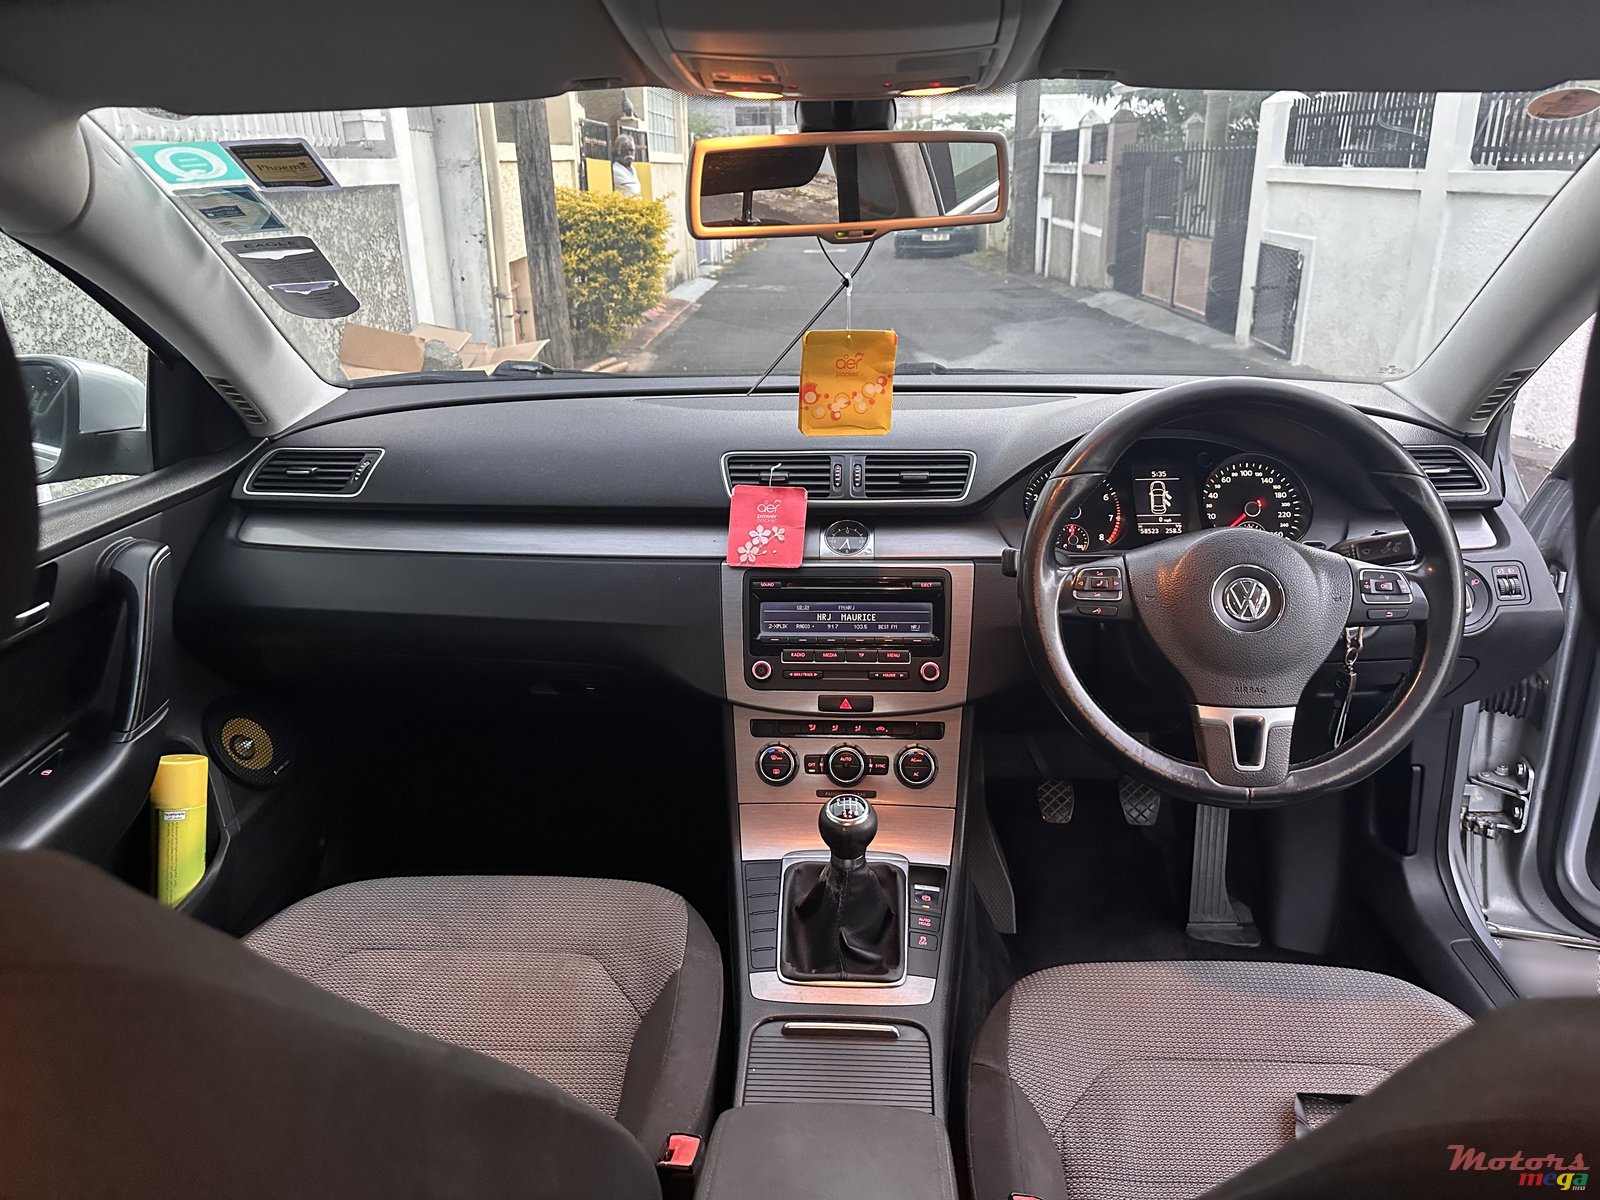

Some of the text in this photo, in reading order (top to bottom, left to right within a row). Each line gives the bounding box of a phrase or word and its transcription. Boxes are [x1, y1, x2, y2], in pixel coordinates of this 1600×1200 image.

[1151, 470, 1167, 478] 5:35
[1239, 469, 1253, 477] 100
[1221, 476, 1232, 484] 60
[1260, 477, 1274, 485] 140
[1033, 493, 1040, 502] 2
[1103, 493, 1110, 502] 6
[1207, 492, 1219, 500] 40
[1274, 491, 1288, 499] 180
[1108, 514, 1115, 523] 7
[1277, 511, 1292, 519] 220
[1099, 533, 1105, 541] 8
[840, 613, 876, 622] MAURICE
[1234, 686, 1267, 694] AIRBAG
